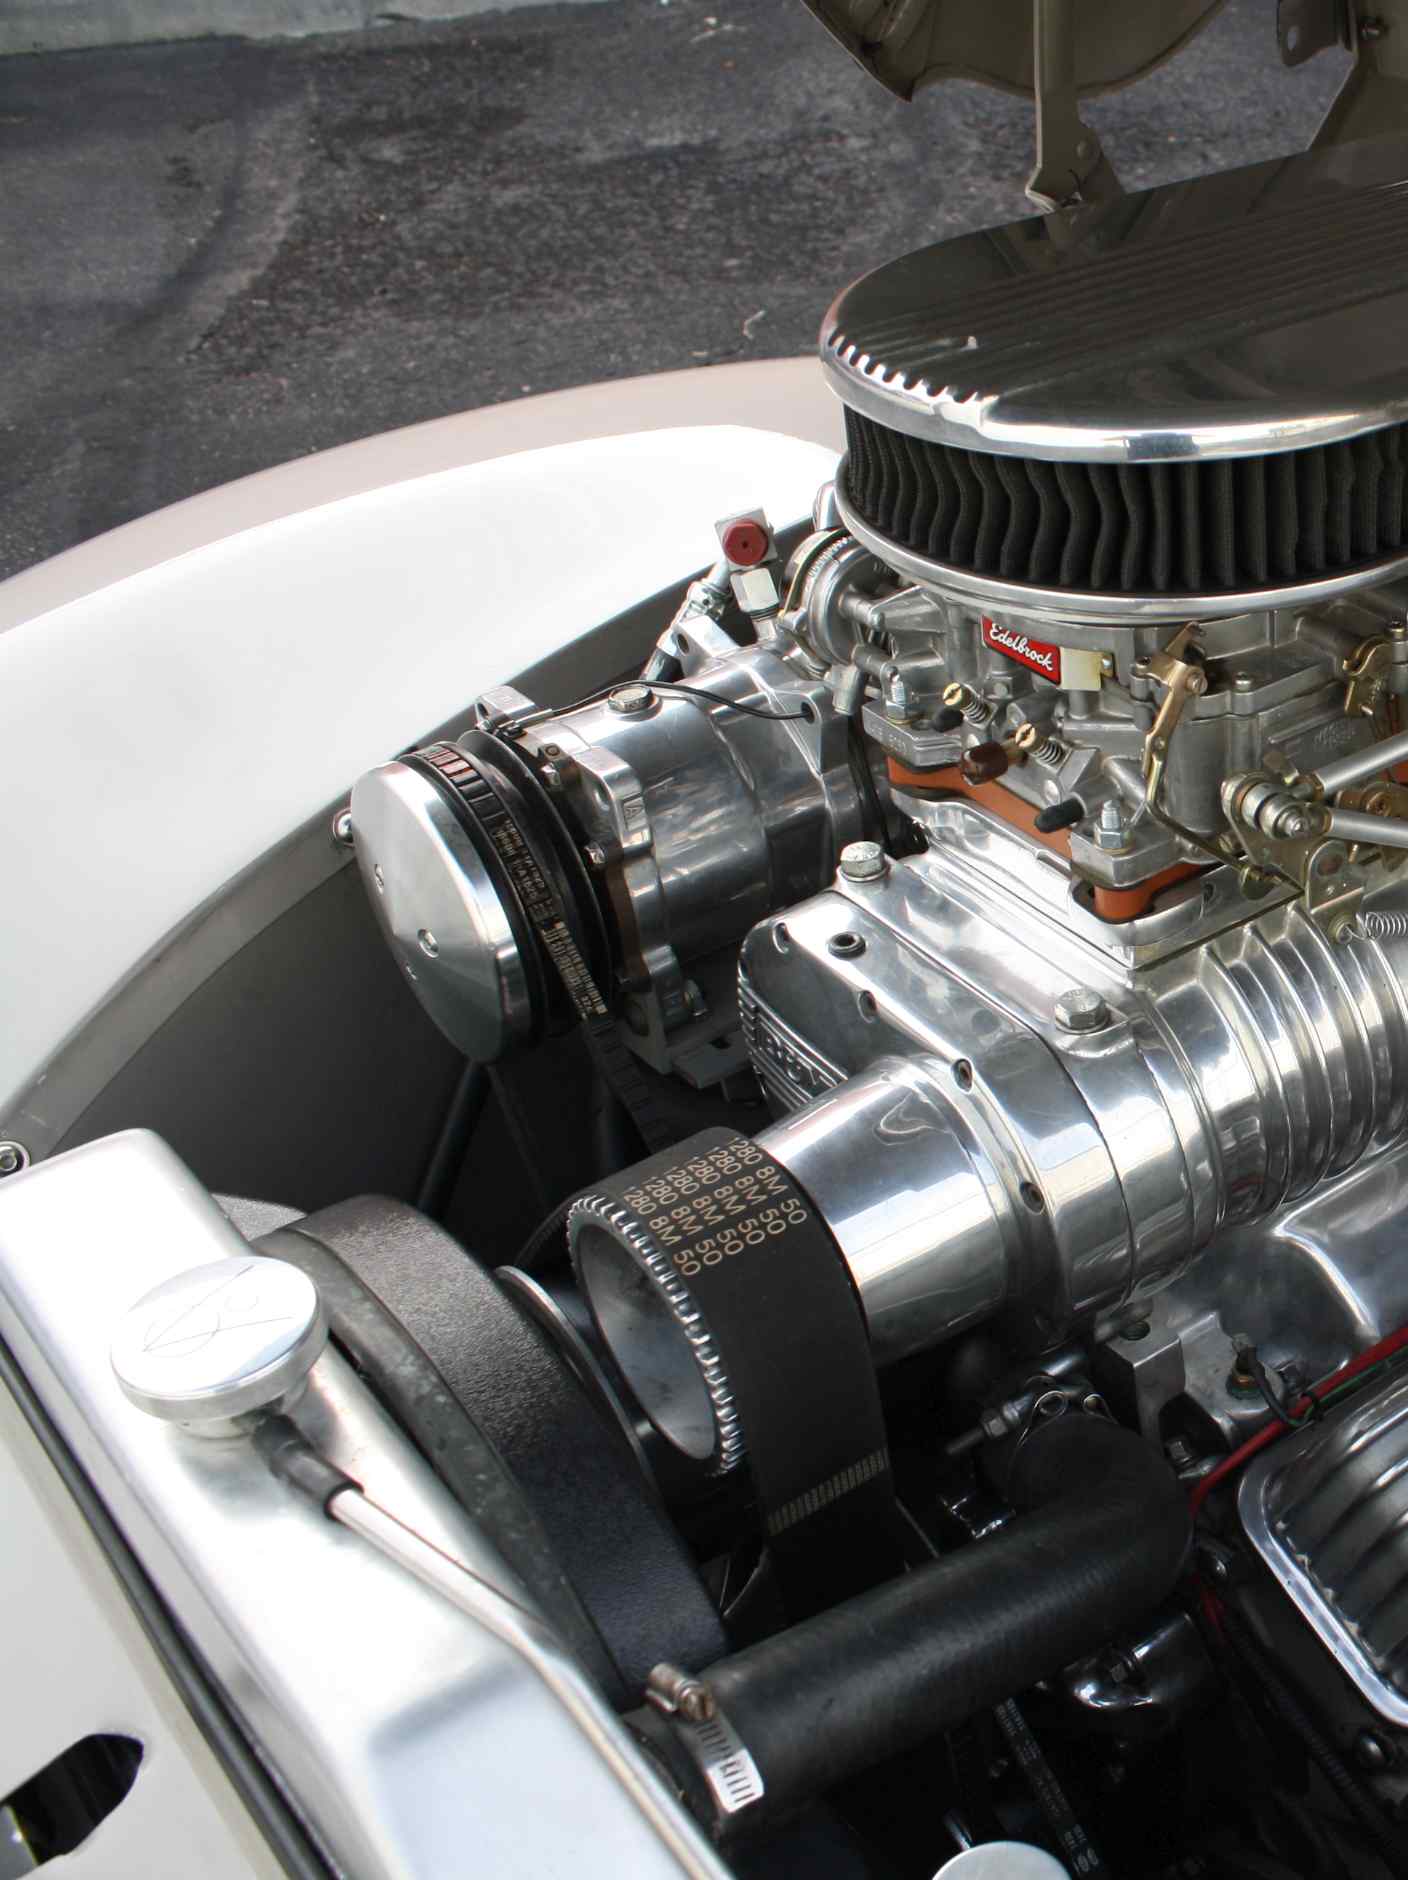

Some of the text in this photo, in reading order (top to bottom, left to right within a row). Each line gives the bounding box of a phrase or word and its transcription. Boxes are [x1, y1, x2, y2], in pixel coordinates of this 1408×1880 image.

[989, 623, 1053, 671] Edelbrock
[643, 1176, 723, 1265] 1280 8M 50
[664, 1166, 744, 1255] 1280 8M 50
[685, 1156, 766, 1245] 1280 8M 50
[706, 1146, 786, 1234] 1280 8M 50
[728, 1137, 807, 1224] 1280 8M 50
[623, 1186, 701, 1276] 1280 8M 50
